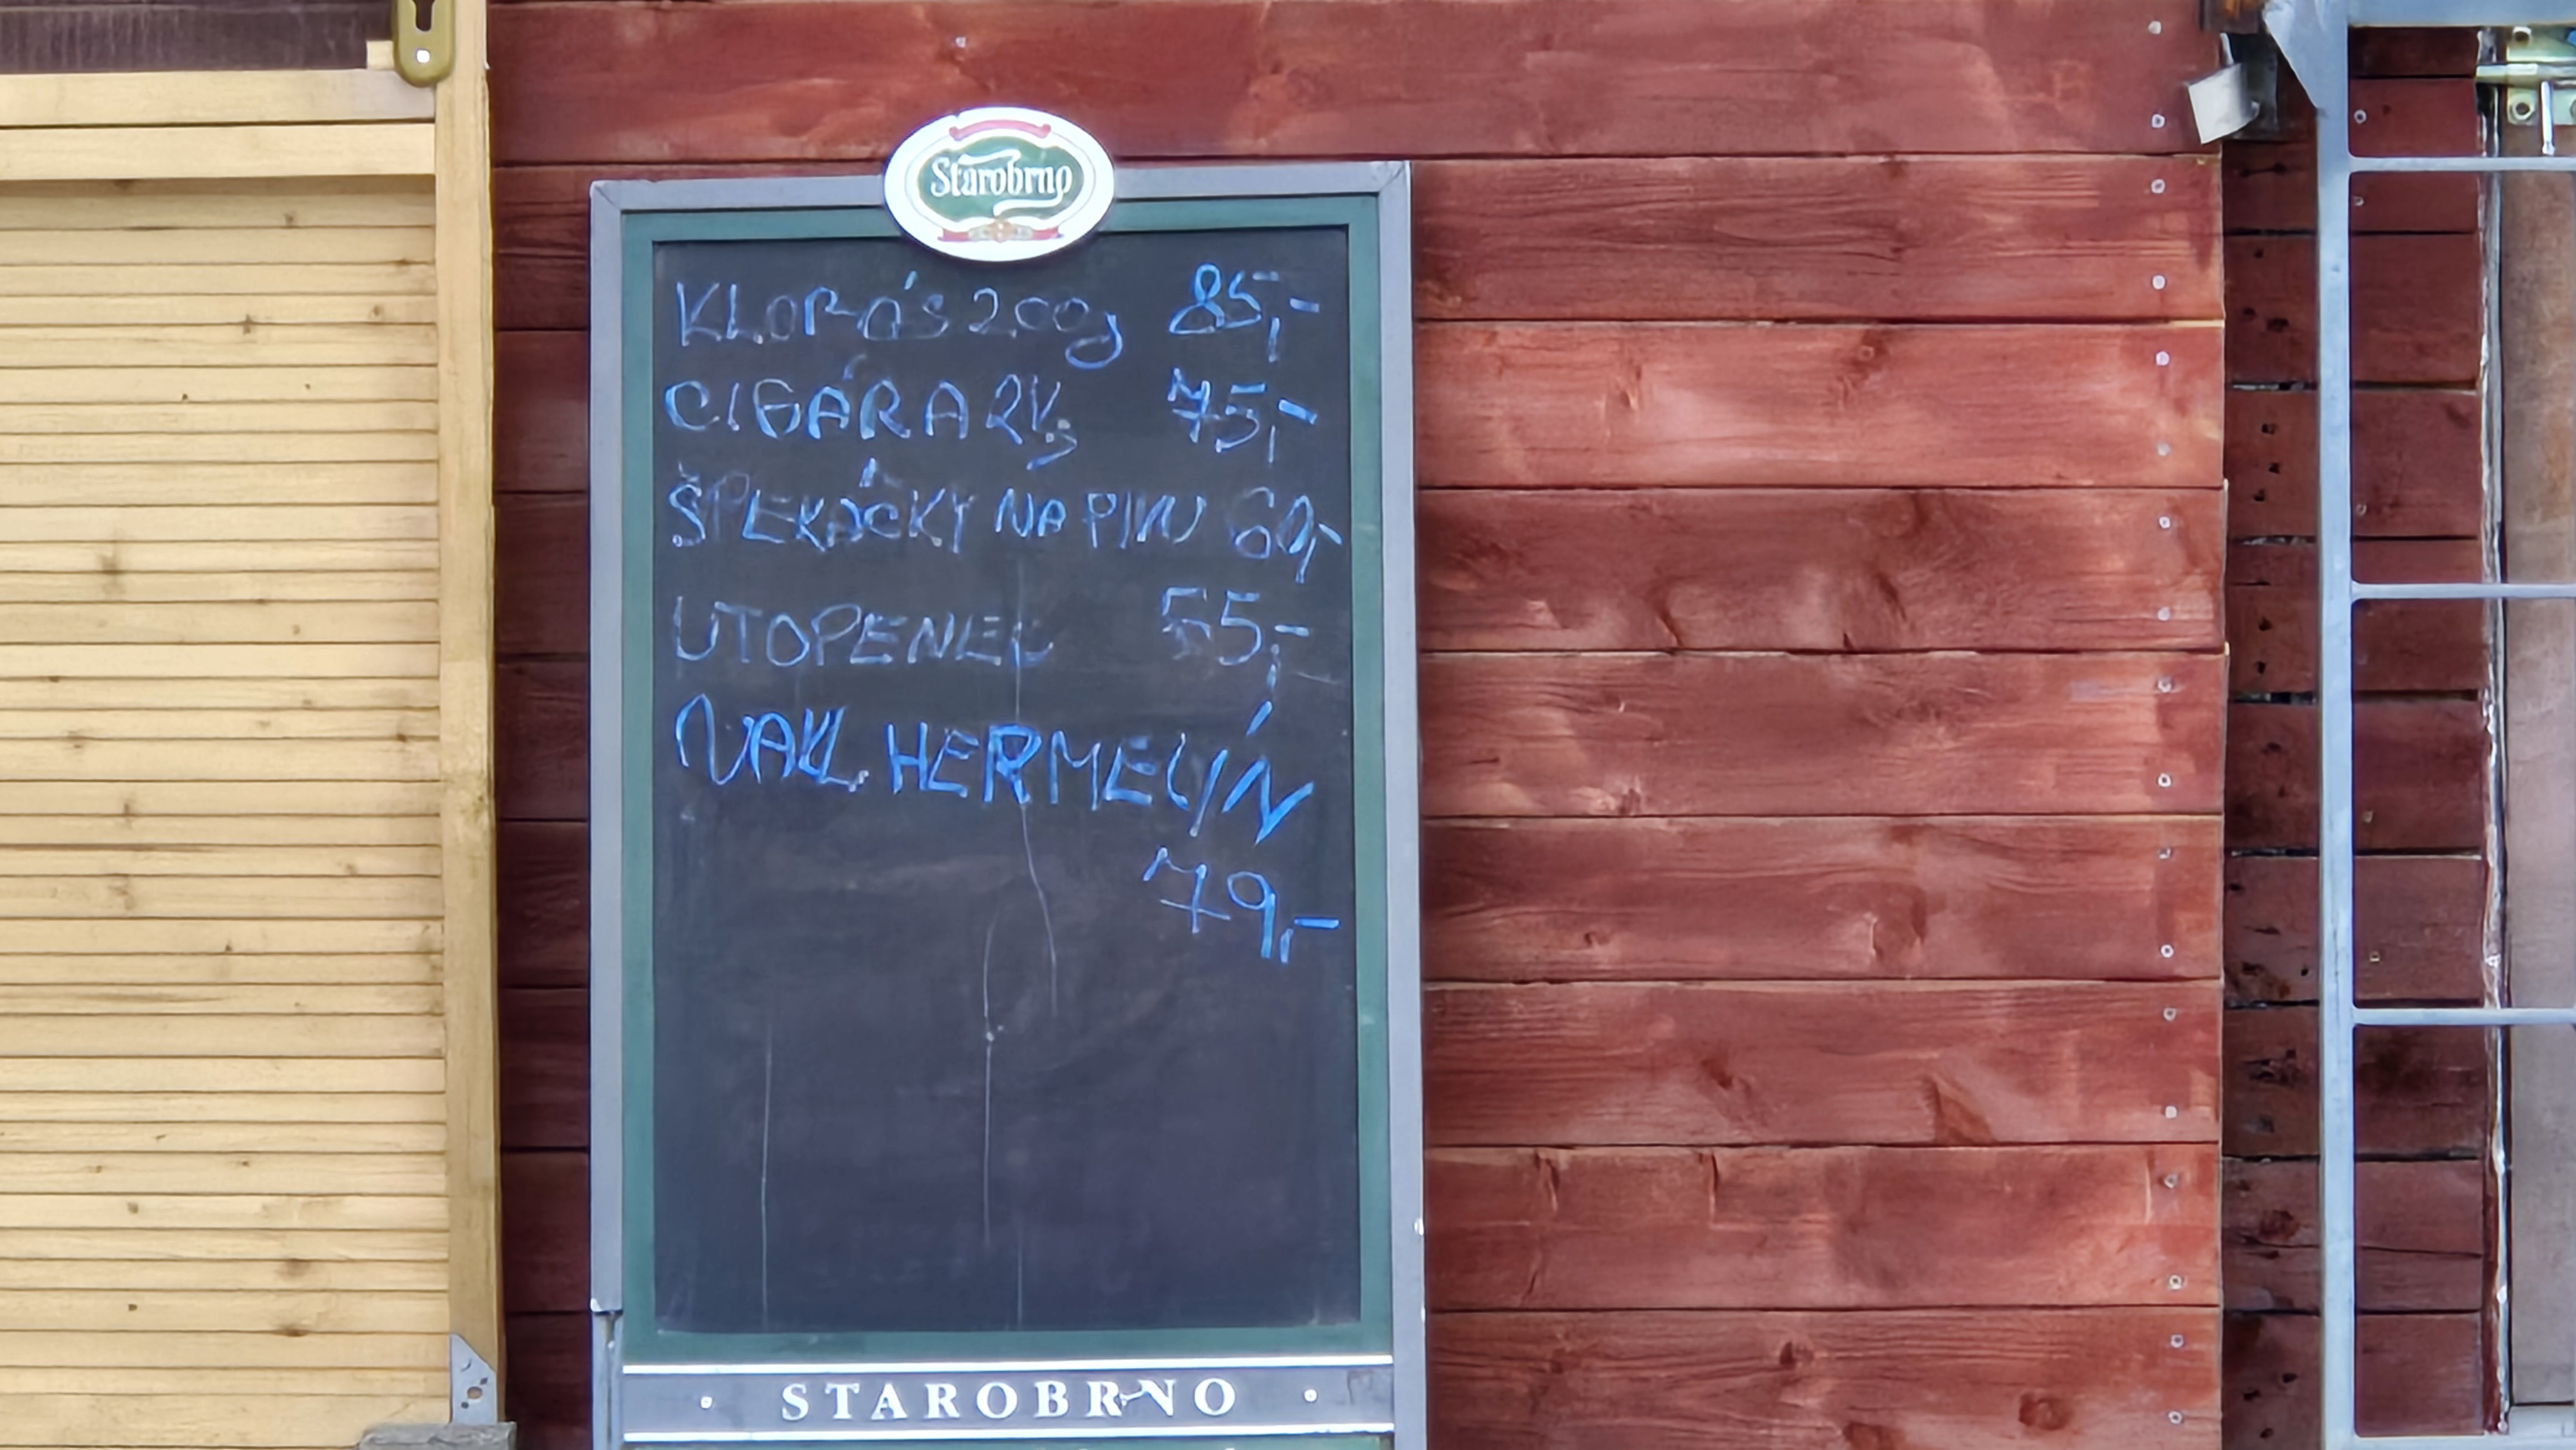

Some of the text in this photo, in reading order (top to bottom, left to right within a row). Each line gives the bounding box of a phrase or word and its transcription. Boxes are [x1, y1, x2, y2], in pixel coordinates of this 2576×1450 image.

[931, 149, 1073, 216] Starobrno
[969, 287, 1123, 370] 200g
[994, 487, 1067, 538] NA
[886, 701, 1315, 845] HERMELÍN
[781, 1377, 1237, 1423] STAROBRNO
